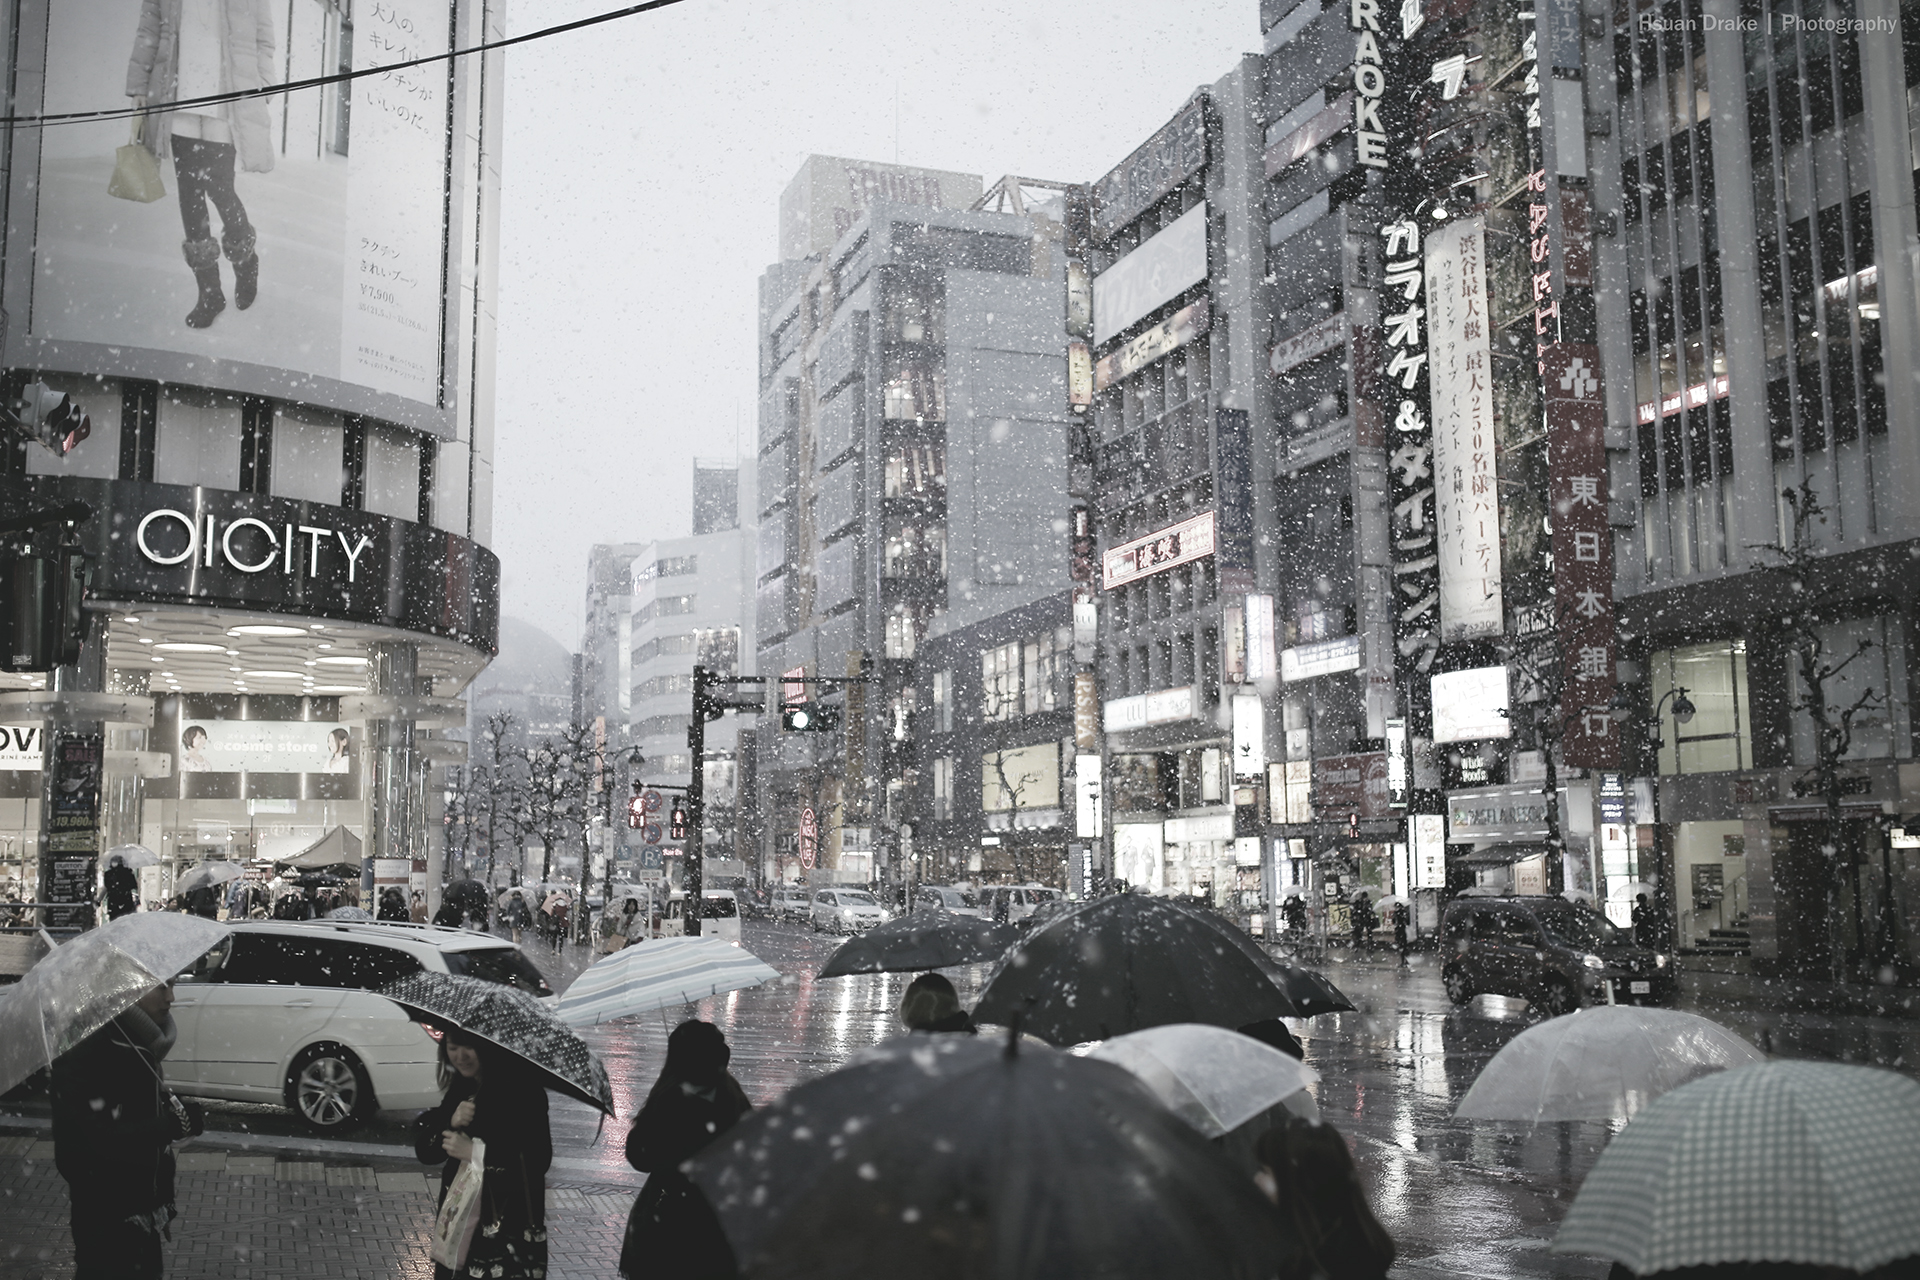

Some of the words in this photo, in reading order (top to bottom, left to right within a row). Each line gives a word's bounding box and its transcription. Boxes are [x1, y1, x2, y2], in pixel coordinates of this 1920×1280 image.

[370, 2, 414, 34] 大人の
[361, 237, 401, 259] ラクチン
[360, 283, 395, 305] ¥7,900
[1459, 233, 1481, 342] 渋谷最大級
[137, 509, 369, 583] OICITY
[1569, 473, 1609, 737] 東日本銀行
[213, 740, 273, 753] @cosme
[277, 740, 318, 753] store
